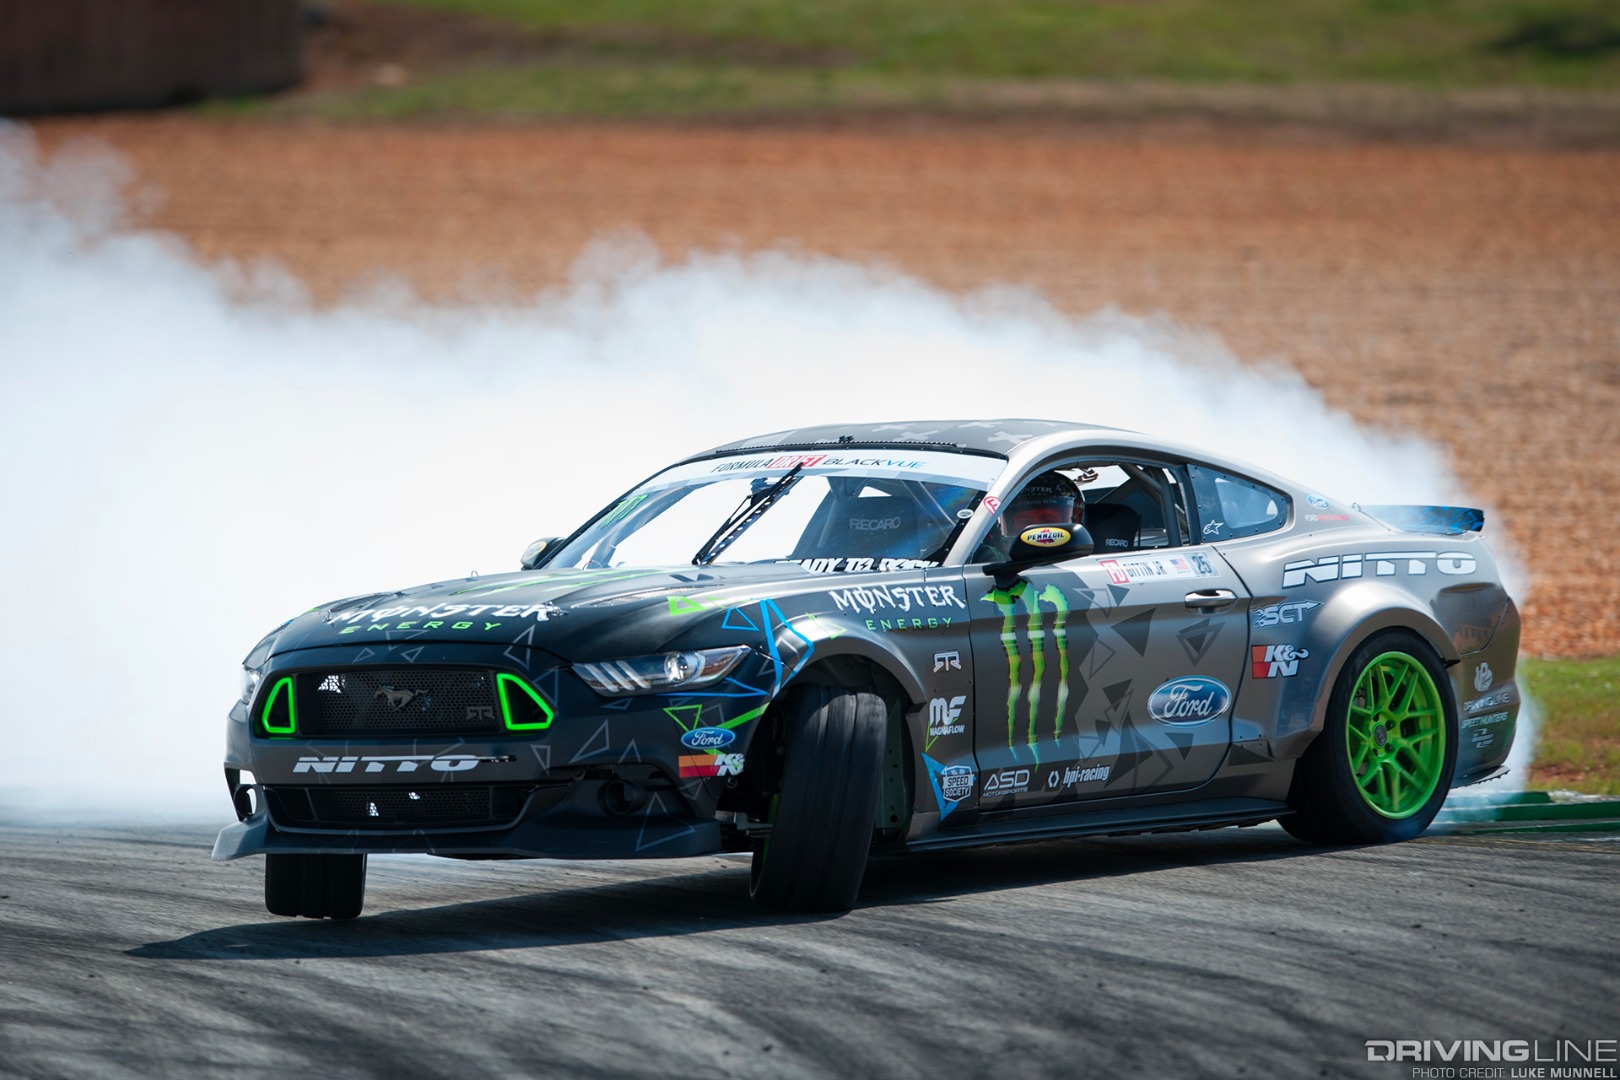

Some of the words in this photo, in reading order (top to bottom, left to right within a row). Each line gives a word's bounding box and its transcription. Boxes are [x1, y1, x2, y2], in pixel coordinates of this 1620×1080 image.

[711, 458, 775, 473] FORMULA
[851, 516, 900, 531] RECARO
[1027, 532, 1065, 541] PENNZOIL
[1105, 538, 1129, 548] RECARO
[1192, 555, 1212, 574] 25
[1282, 551, 1477, 588] NITTO
[1259, 602, 1318, 628] SCT
[338, 620, 502, 634] ENERGY
[865, 617, 952, 631] ENERGY
[1164, 684, 1215, 718] Ford
[691, 730, 724, 746] Ford
[292, 754, 481, 773] NITTO
[947, 776, 969, 787] SPEED
[945, 786, 970, 798] SOCIETY
[983, 787, 1029, 798] MOTORSPORTS
